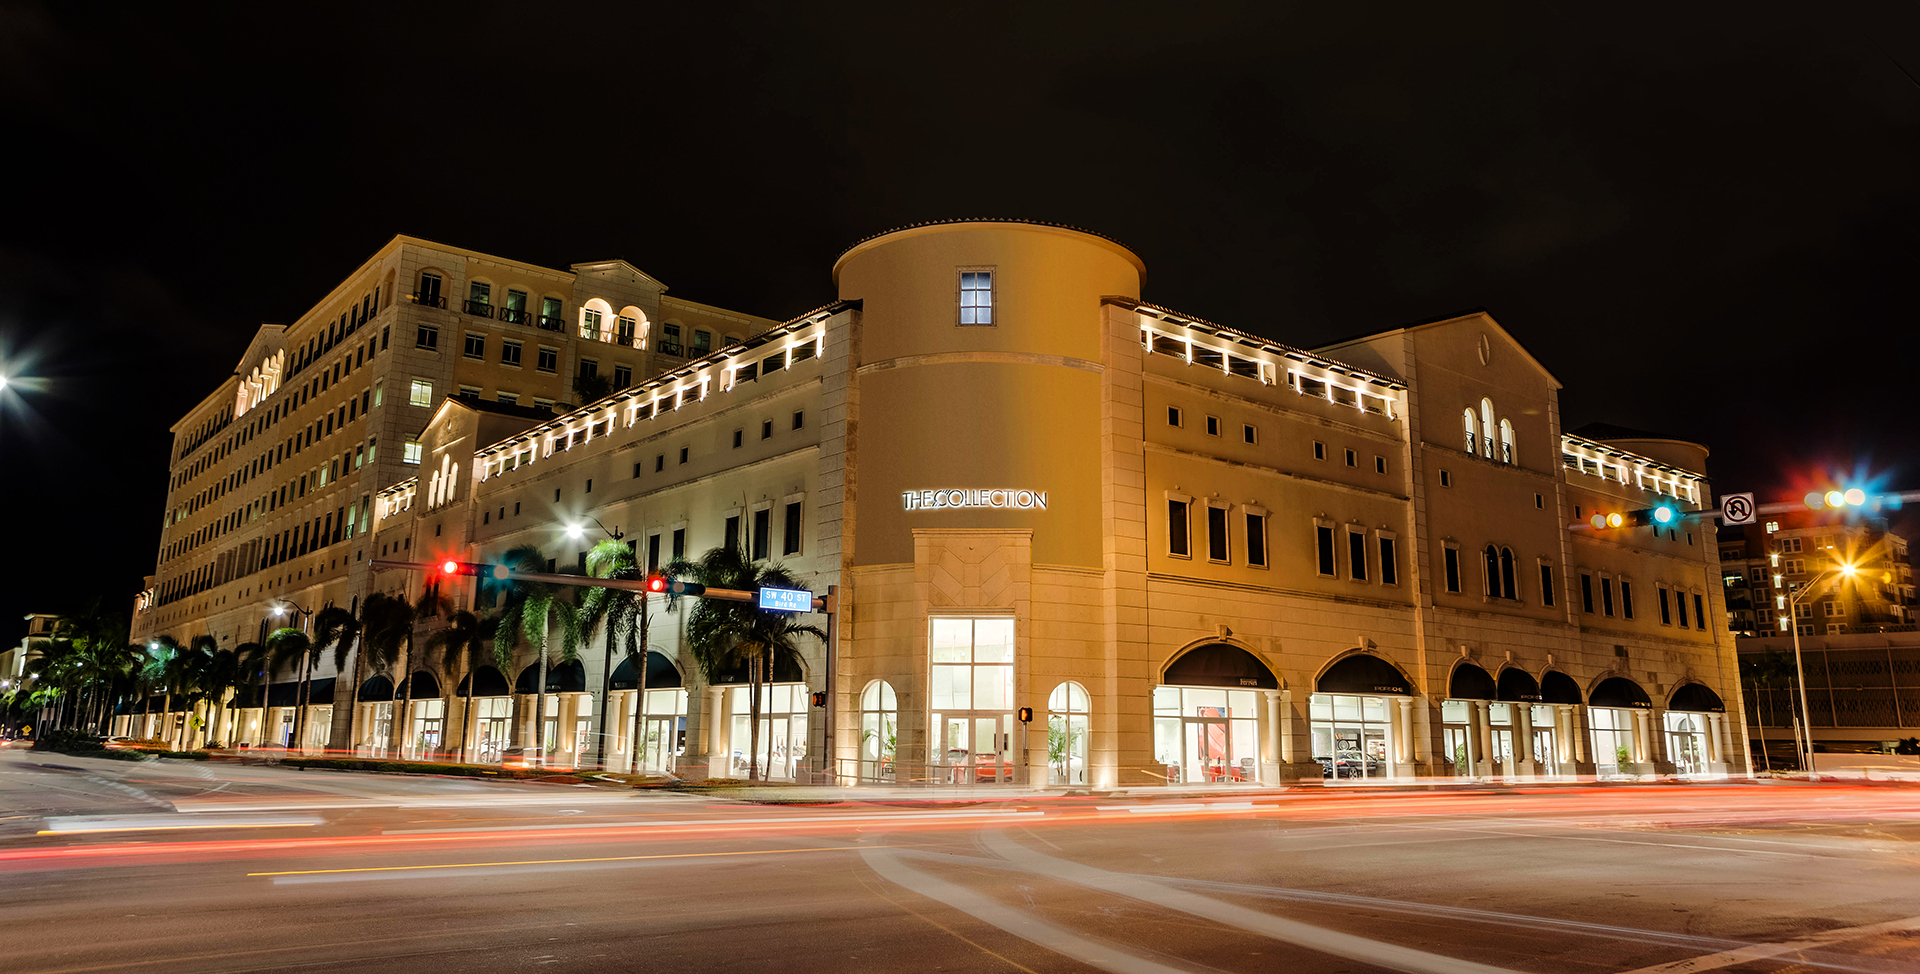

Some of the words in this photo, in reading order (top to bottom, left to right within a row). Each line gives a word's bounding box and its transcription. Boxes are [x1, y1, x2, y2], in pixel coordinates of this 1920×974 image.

[766, 591, 777, 599] SW
[781, 592, 793, 602] 40
[797, 594, 806, 602] ST
